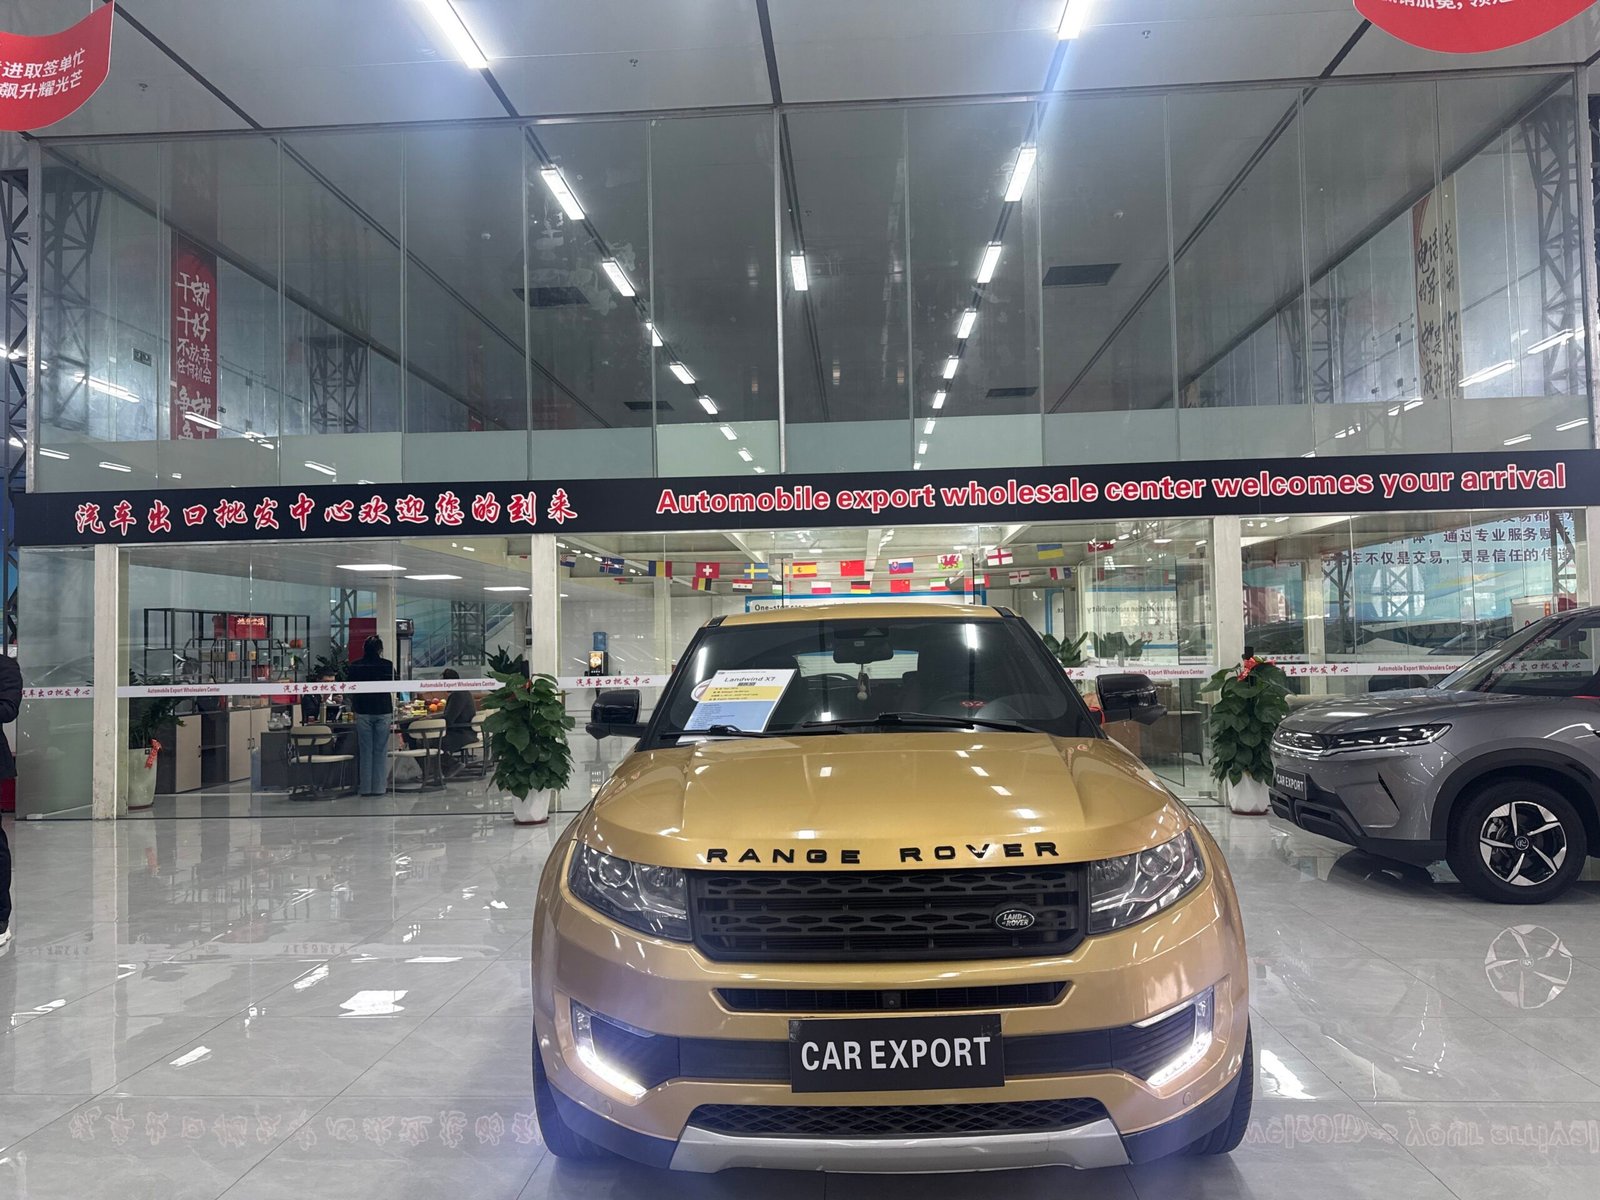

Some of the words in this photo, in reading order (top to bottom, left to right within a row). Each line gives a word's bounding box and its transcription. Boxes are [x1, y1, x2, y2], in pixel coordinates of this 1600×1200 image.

[0, 48, 86, 78] 进取签单忙
[656, 485, 829, 514] Automobile
[836, 484, 935, 514] export
[940, 477, 1098, 506] wholesale
[1104, 475, 1206, 500] center
[1212, 470, 1374, 498] welcomes
[1379, 471, 1454, 499] your
[1460, 463, 1566, 491] arrival
[75, 488, 578, 536] 汽车出口批发中心欢迎您的到来
[576, 676, 650, 687] 汽车出口批发中心
[706, 848, 861, 864] RANGE
[899, 842, 1060, 862] ROVER
[1003, 913, 1023, 921] LAND
[1005, 919, 1029, 927] ROVER
[801, 1041, 862, 1071] CAR
[869, 1036, 991, 1069] EXPORT
